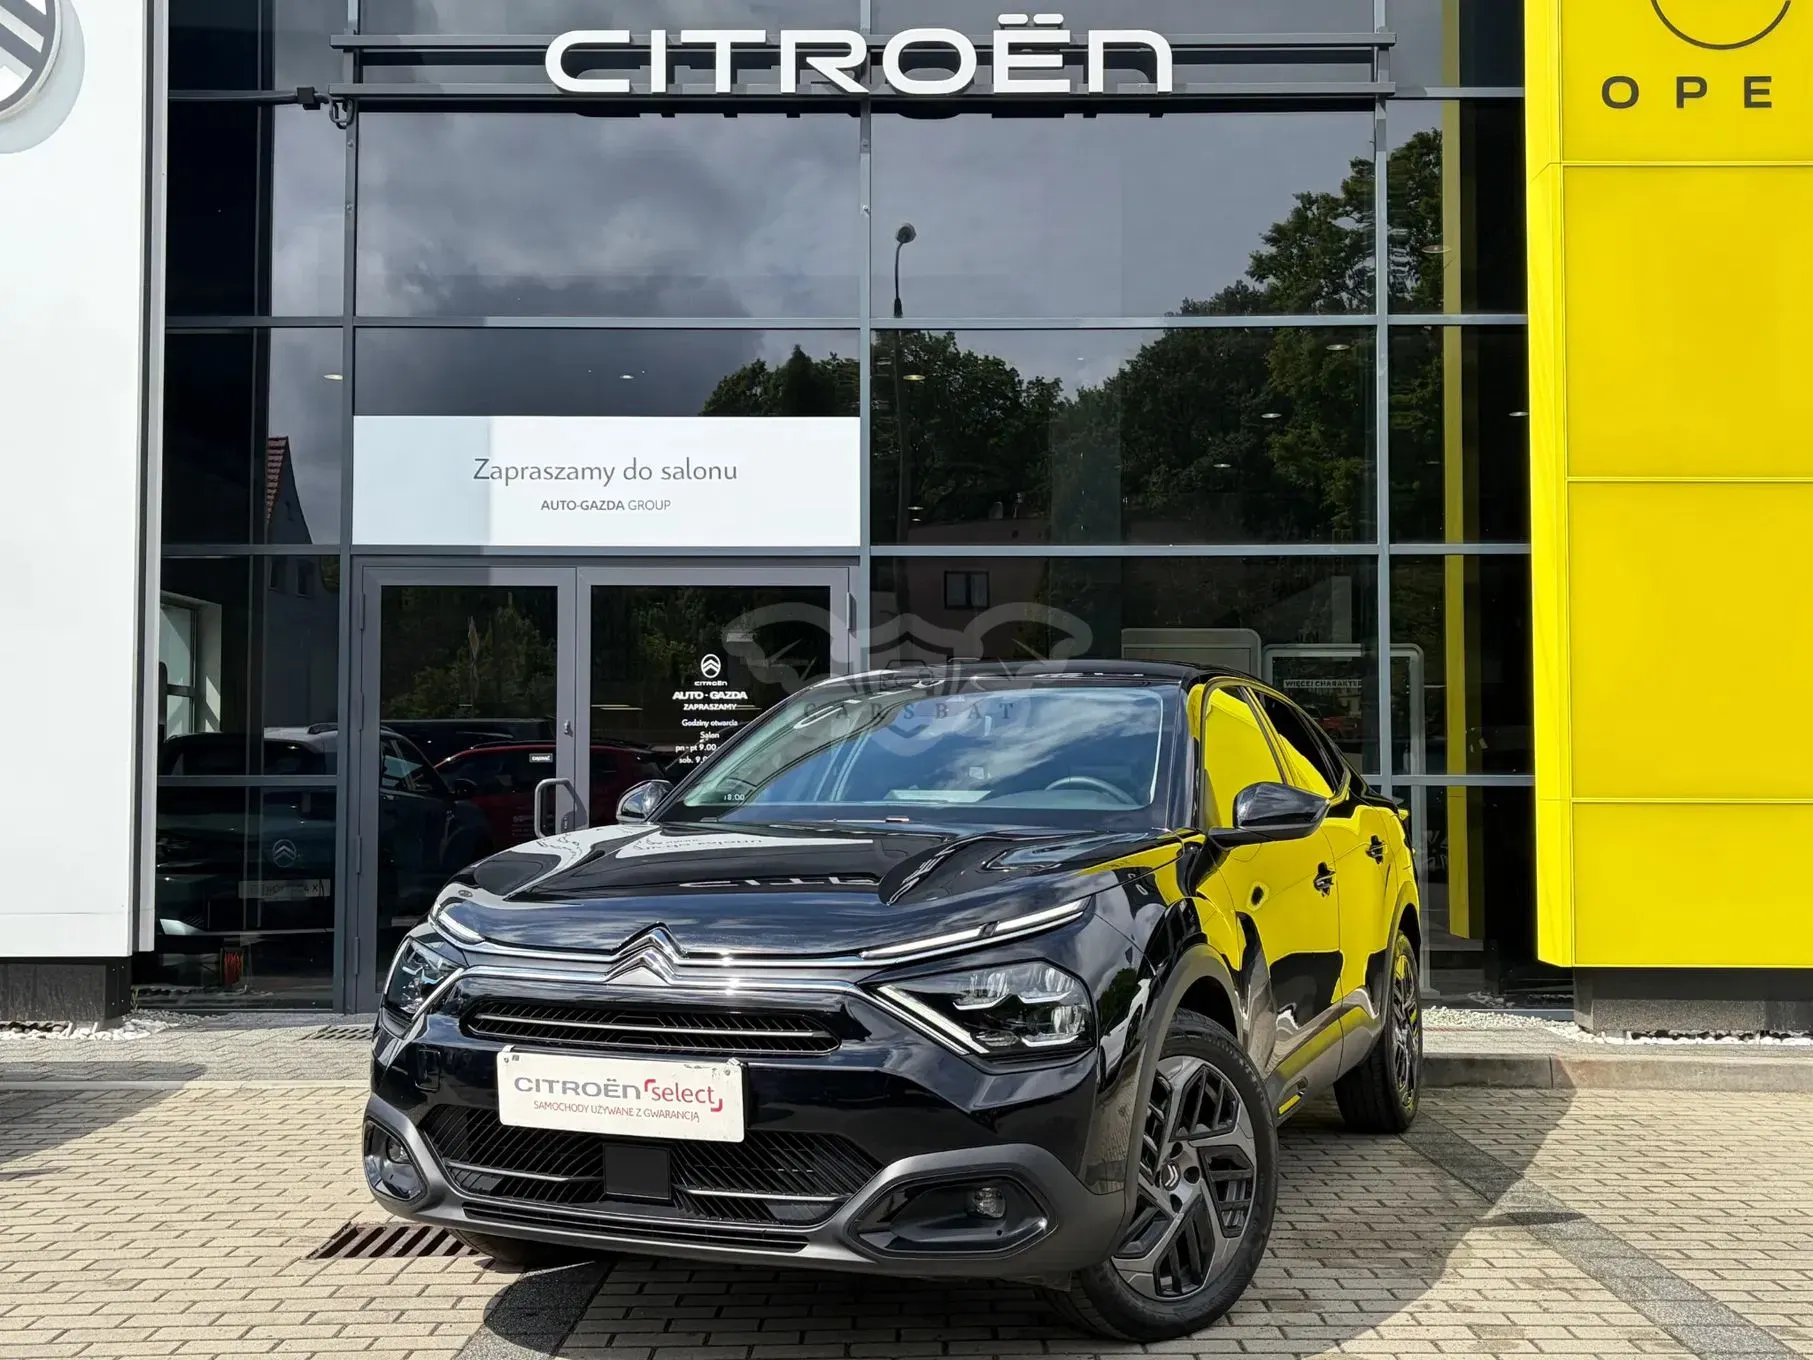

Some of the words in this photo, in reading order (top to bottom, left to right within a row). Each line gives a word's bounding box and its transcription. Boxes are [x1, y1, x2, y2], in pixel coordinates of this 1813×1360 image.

[1601, 75, 1773, 109] OPE
[473, 457, 615, 487] Zapraszamy
[623, 456, 653, 480] do
[660, 456, 737, 480] salonu
[540, 500, 625, 511] AUTO-GAZDA
[627, 499, 672, 511] GROUP
[683, 703, 737, 711] ZAPRASZAMY
[681, 718, 709, 728] Godziny
[710, 719, 738, 727] otwarcia
[700, 731, 719, 739] Salon
[699, 743, 717, 751] 9.00
[651, 1082, 715, 1104] select
[533, 1100, 589, 1113] SAMOCHODY
[636, 1108, 643, 1118] Z
[643, 1108, 700, 1123] GWARANCJĄ
